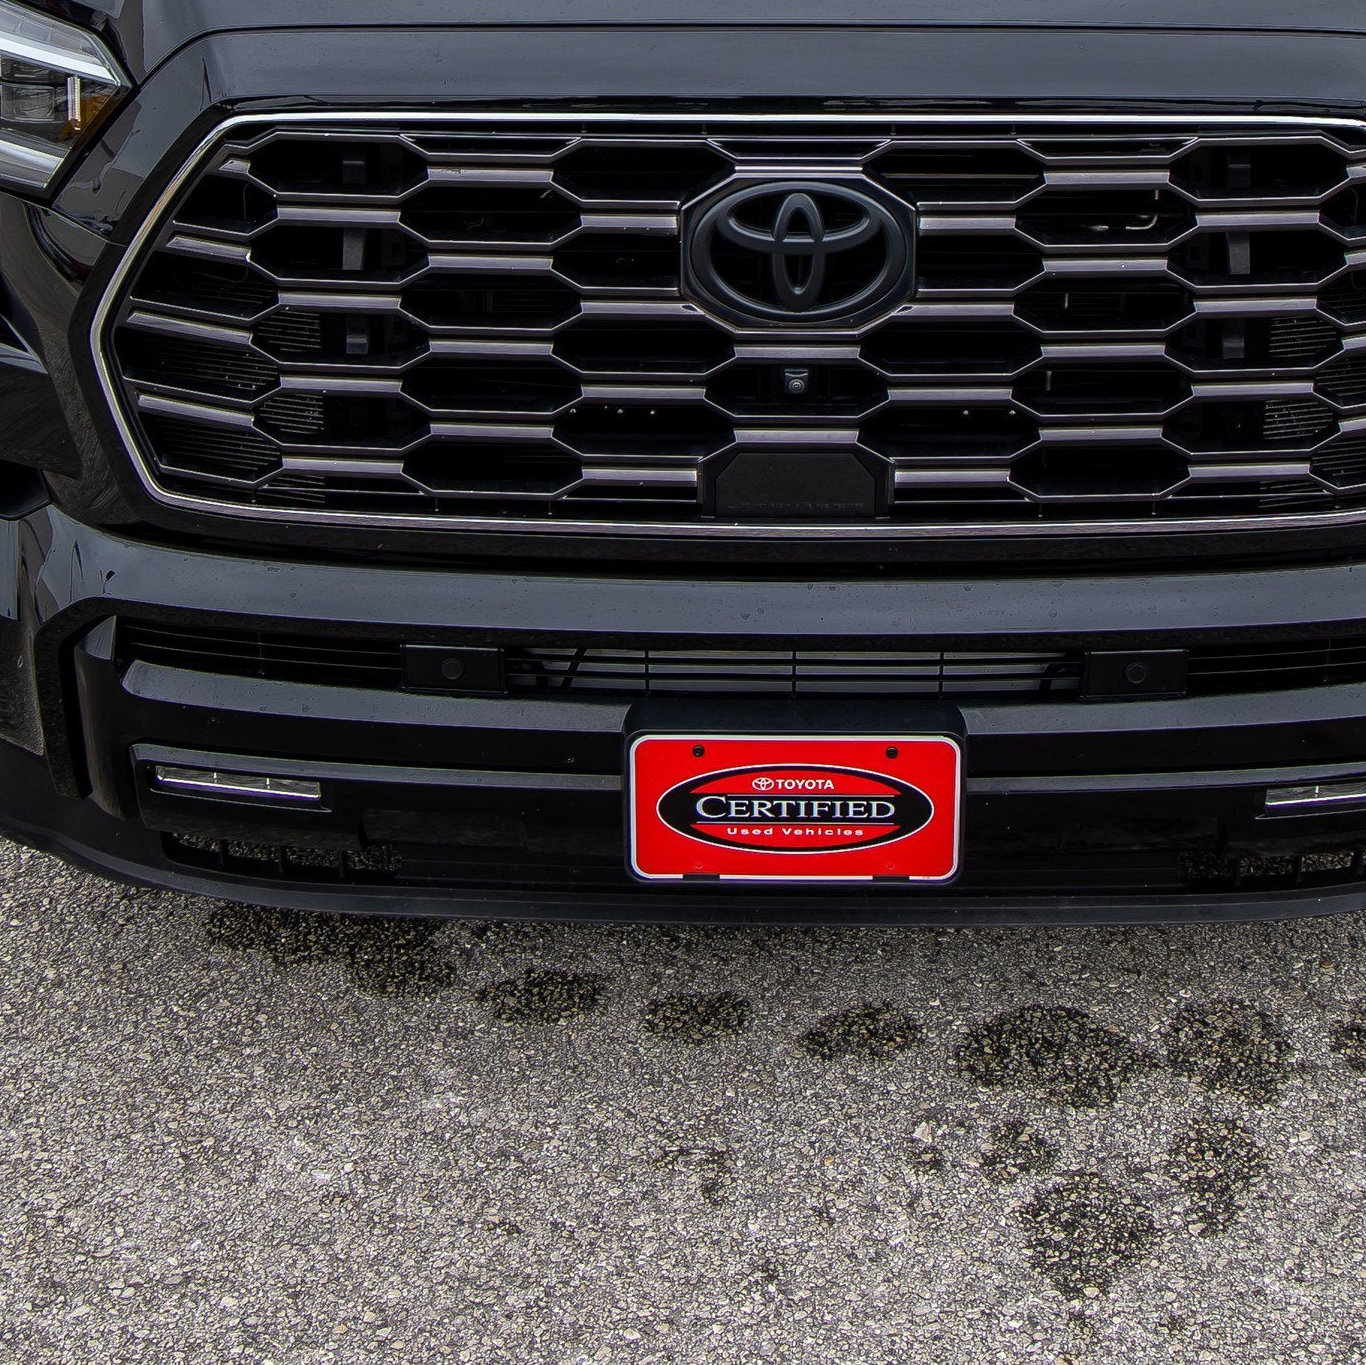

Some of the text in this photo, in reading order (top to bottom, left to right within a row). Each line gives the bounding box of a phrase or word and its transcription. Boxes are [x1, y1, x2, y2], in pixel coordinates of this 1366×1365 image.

[775, 779, 835, 790] TOYOTA
[695, 795, 896, 819] CERTIFIED
[727, 827, 864, 836] Used Vehicles
